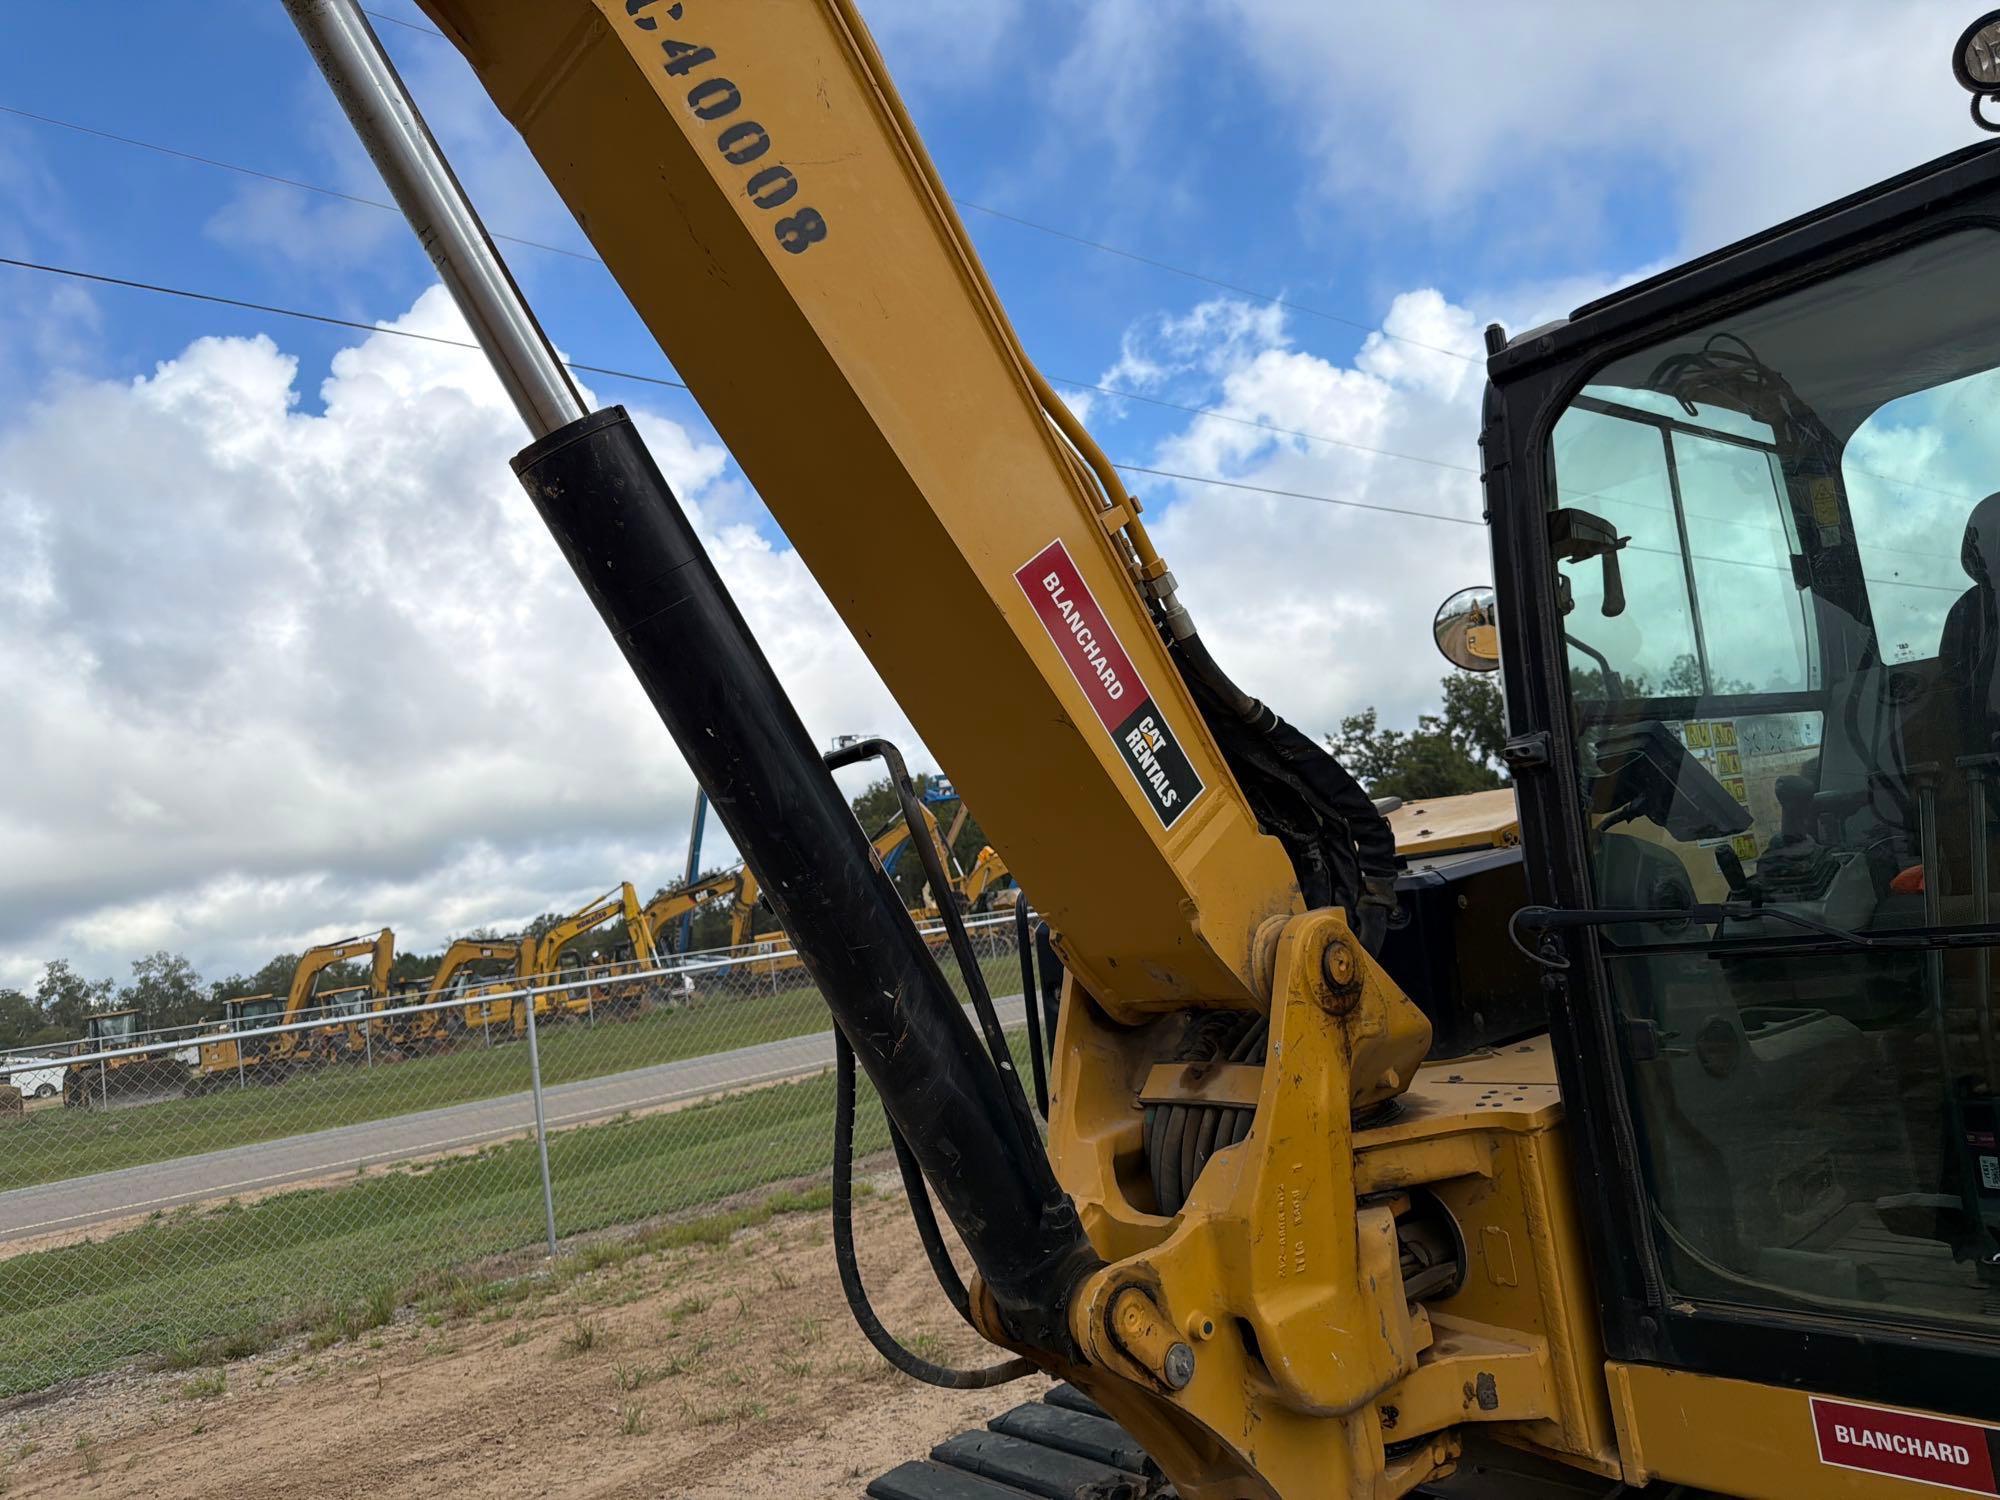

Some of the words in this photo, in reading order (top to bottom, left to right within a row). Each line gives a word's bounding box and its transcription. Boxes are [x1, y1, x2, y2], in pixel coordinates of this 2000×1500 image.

[625, 0, 827, 254] C40008
[1042, 571, 1124, 701] BLANCHARD
[1125, 728, 1177, 808] RENTALS
[1139, 716, 1167, 753] CAT
[1834, 1424, 1970, 1466] BLANCHARD
